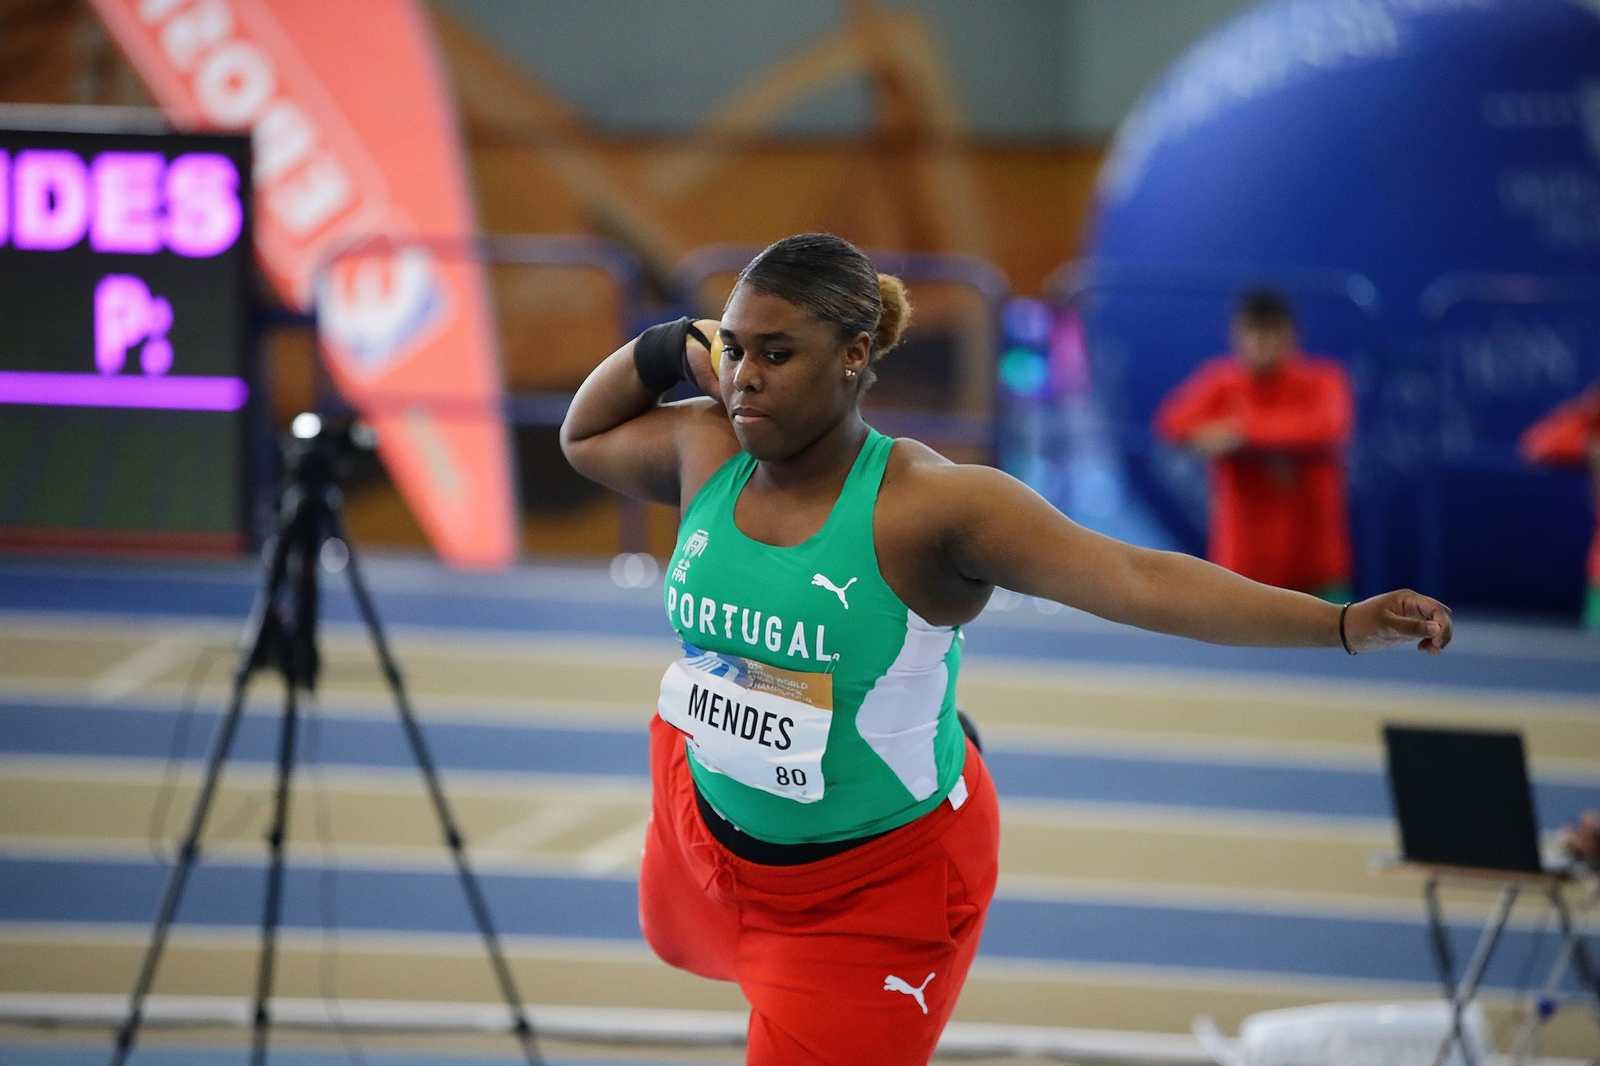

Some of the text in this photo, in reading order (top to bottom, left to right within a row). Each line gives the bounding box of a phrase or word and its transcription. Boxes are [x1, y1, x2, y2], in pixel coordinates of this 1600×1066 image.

[0, 148, 244, 259] DES
[671, 567, 687, 584] FPA
[667, 586, 832, 662] PORTUGAL
[688, 684, 795, 750] MENDES
[776, 766, 807, 786] 80
